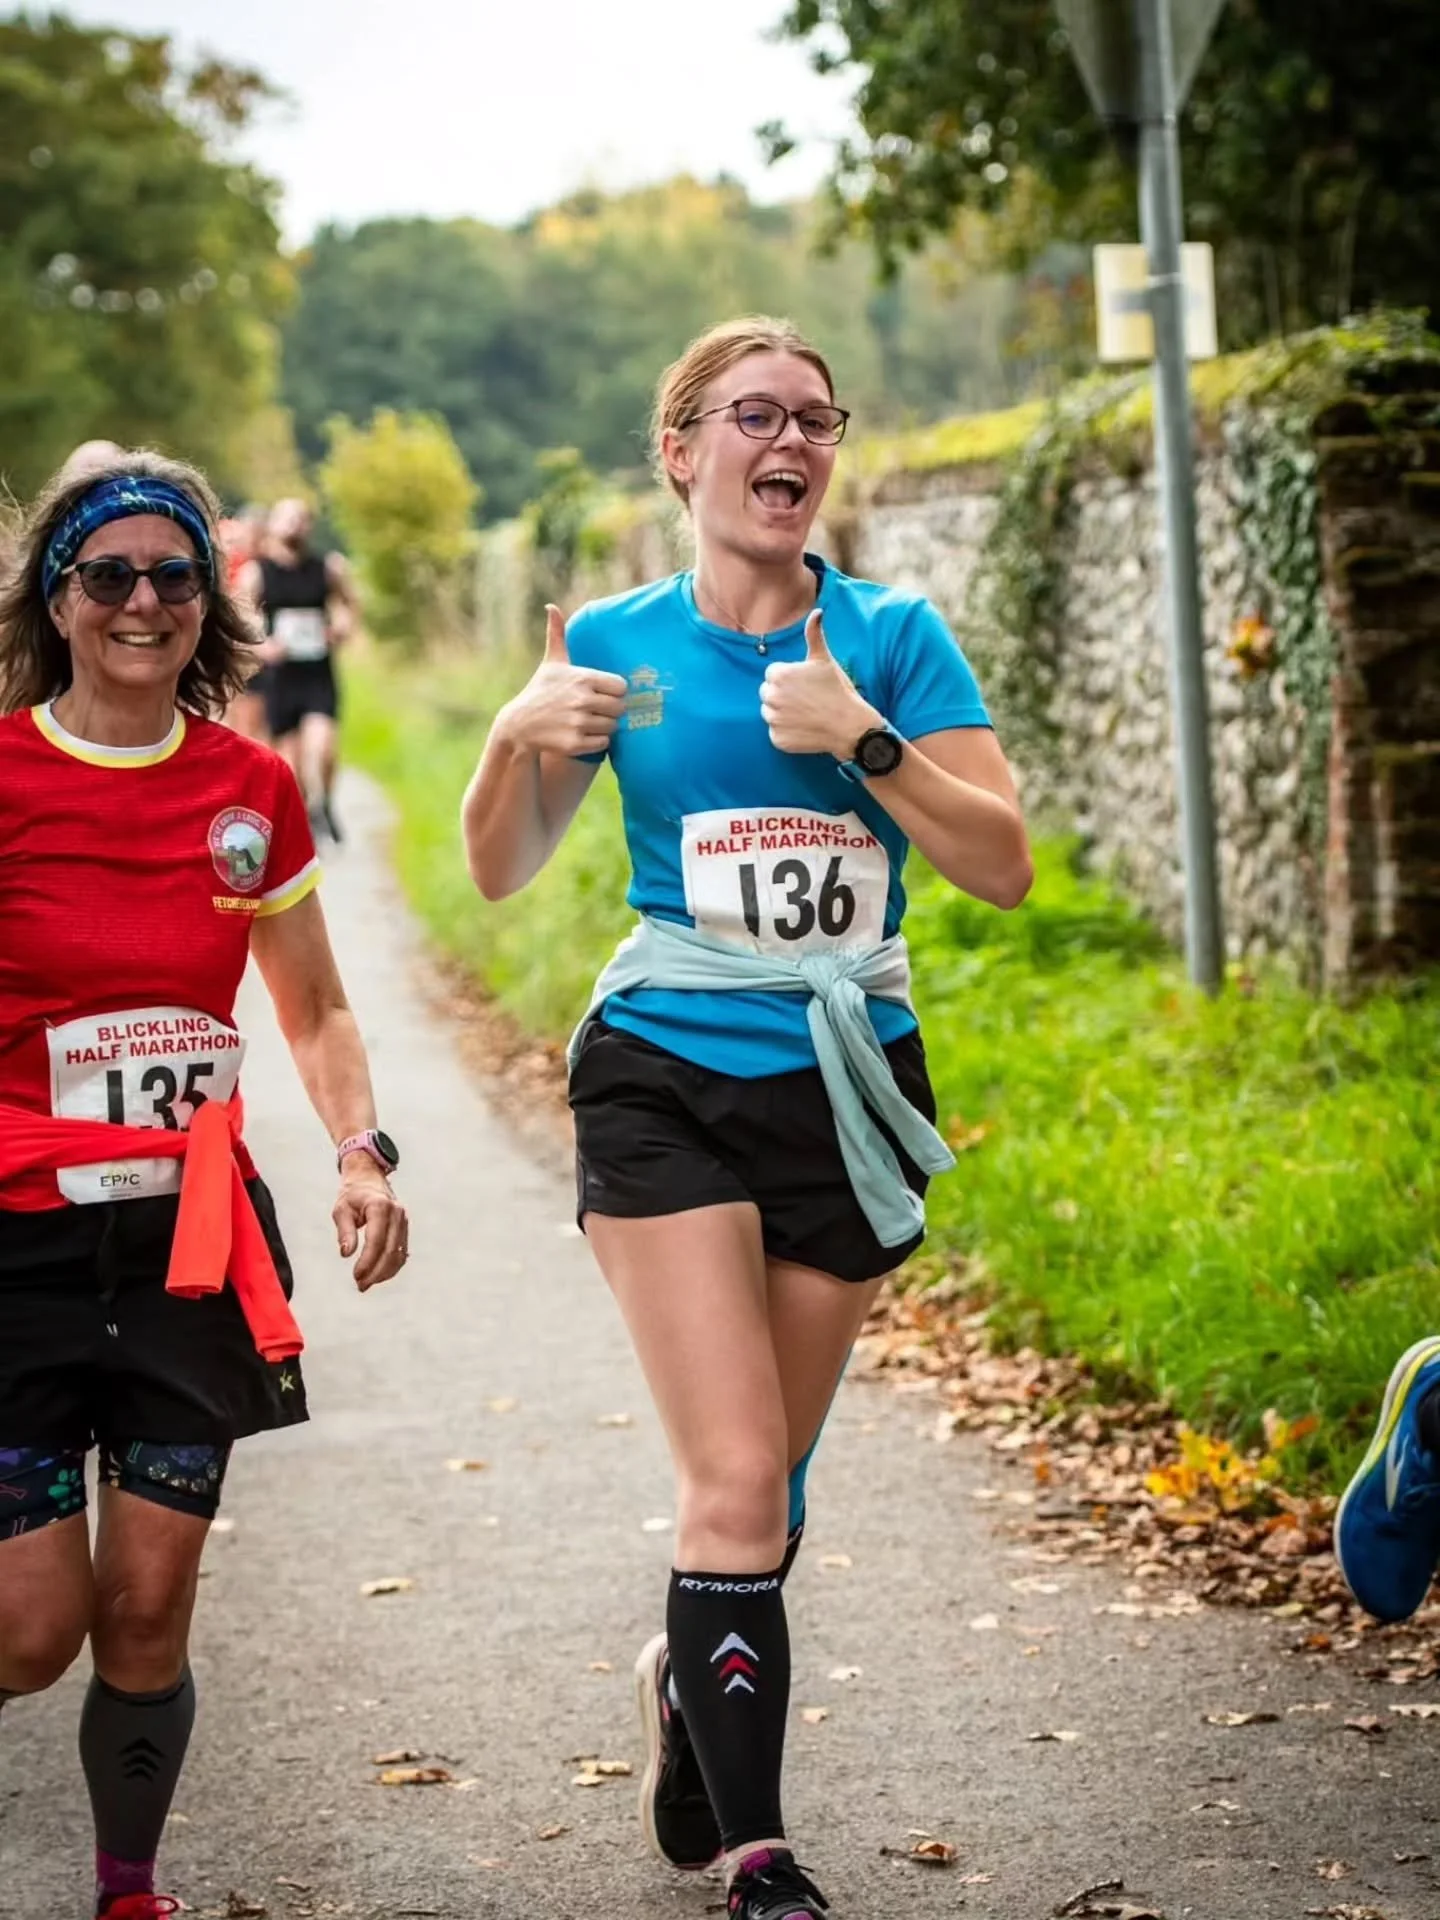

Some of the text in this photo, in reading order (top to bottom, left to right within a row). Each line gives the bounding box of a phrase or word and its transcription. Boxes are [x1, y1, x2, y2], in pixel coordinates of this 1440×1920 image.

[730, 817, 846, 835] BLICKLING
[696, 833, 877, 856] HALF MARATHON
[738, 856, 856, 941] 136
[97, 1016, 210, 1041] BLICKLING
[66, 1034, 240, 1065] HALF MARATHON
[679, 1578, 779, 1593] RYMORA
